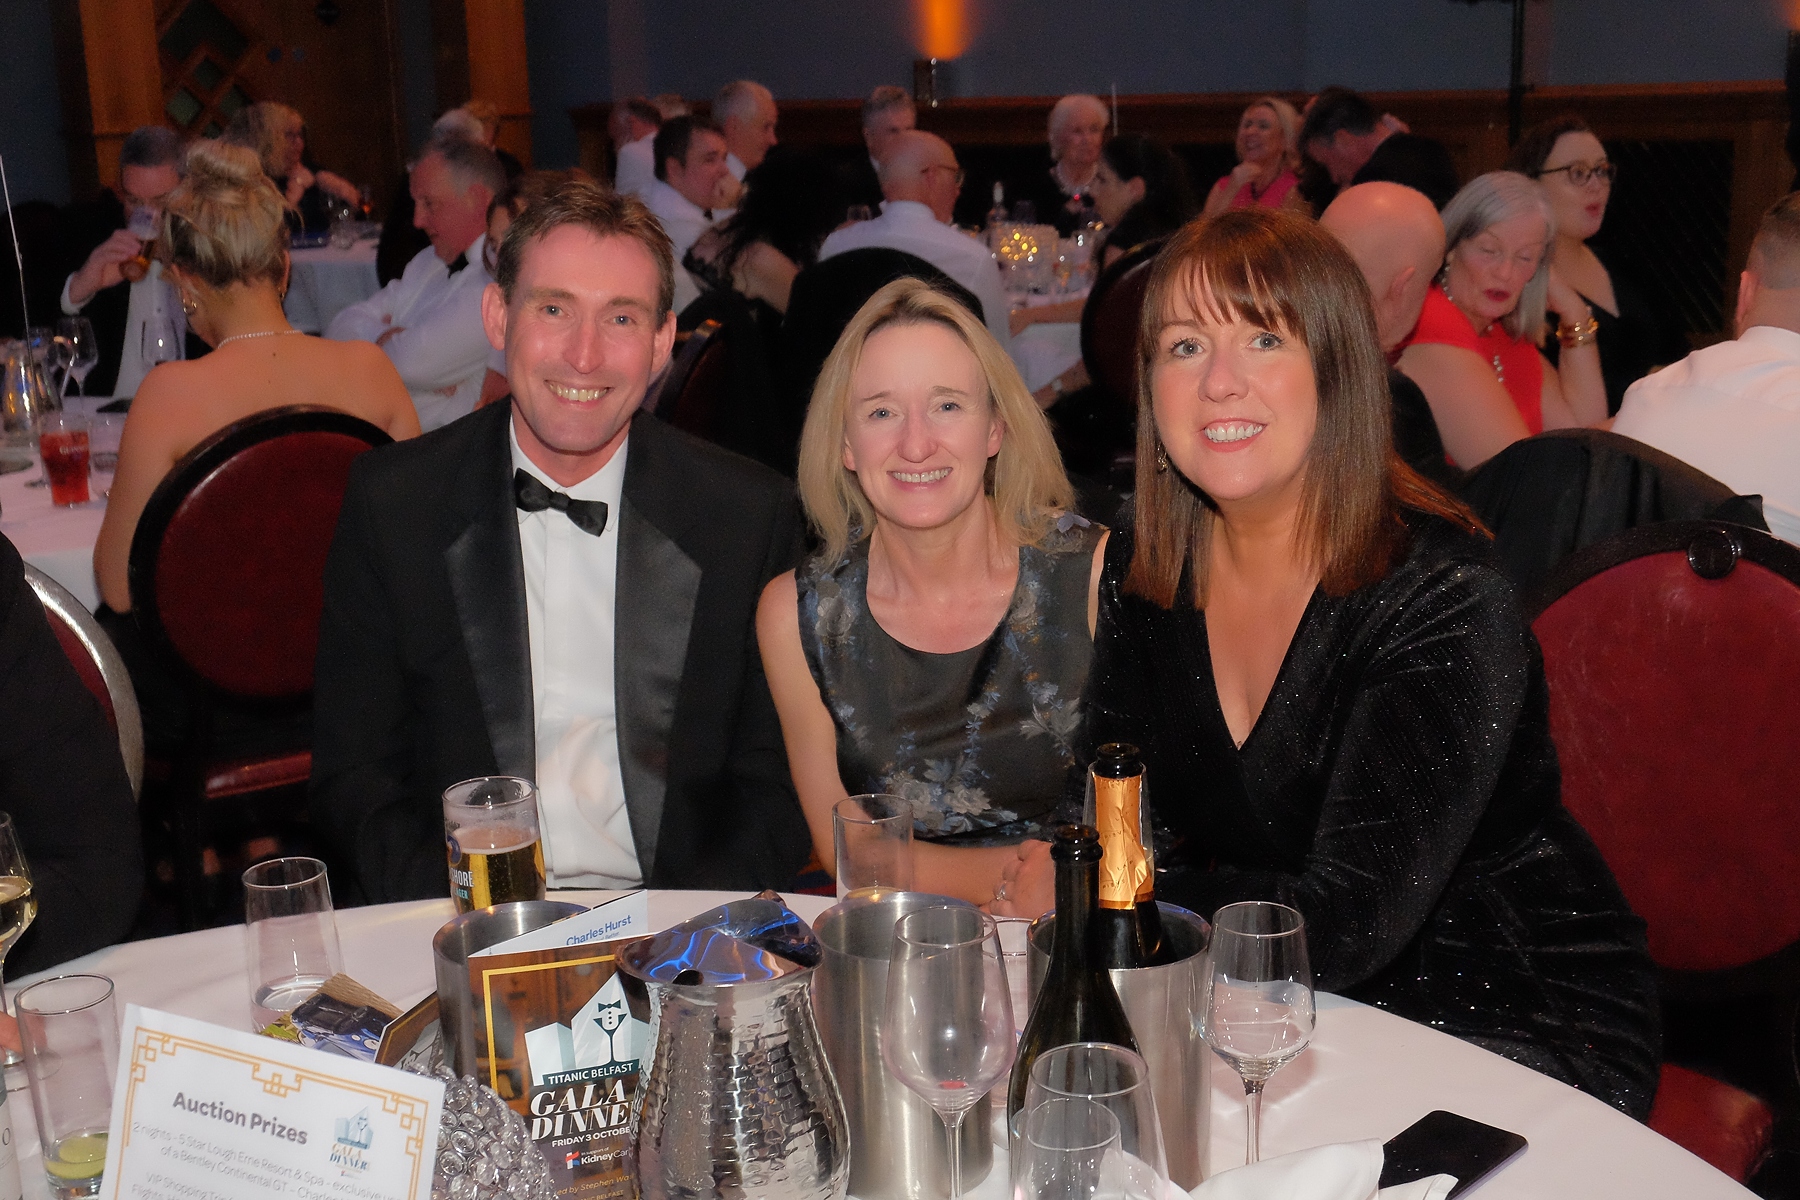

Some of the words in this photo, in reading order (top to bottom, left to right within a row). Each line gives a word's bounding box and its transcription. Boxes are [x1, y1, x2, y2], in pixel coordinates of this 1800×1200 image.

[566, 928, 603, 945] Charles
[605, 914, 632, 932] Hurst
[548, 1070, 589, 1085] TITANIC
[591, 1062, 633, 1078] BELFAST
[530, 1079, 628, 1117] GALA
[173, 1092, 247, 1127] Auction
[250, 1112, 308, 1145] Prizes
[531, 1102, 630, 1141] DINNE
[552, 1134, 585, 1147] FRIDAY
[585, 1133, 592, 1142] 3
[593, 1126, 631, 1139] OCTOBE
[132, 1121, 141, 1133] 2
[185, 1135, 206, 1150] Star
[207, 1142, 238, 1161] Lough
[238, 1151, 260, 1167] Erne
[294, 1168, 302, 1180] &
[304, 1171, 324, 1187] Spa
[581, 1149, 629, 1165] KidneyCar
[217, 1161, 271, 1188] Continental
[580, 1179, 614, 1191] Stephen
[616, 1175, 630, 1183] Wa
